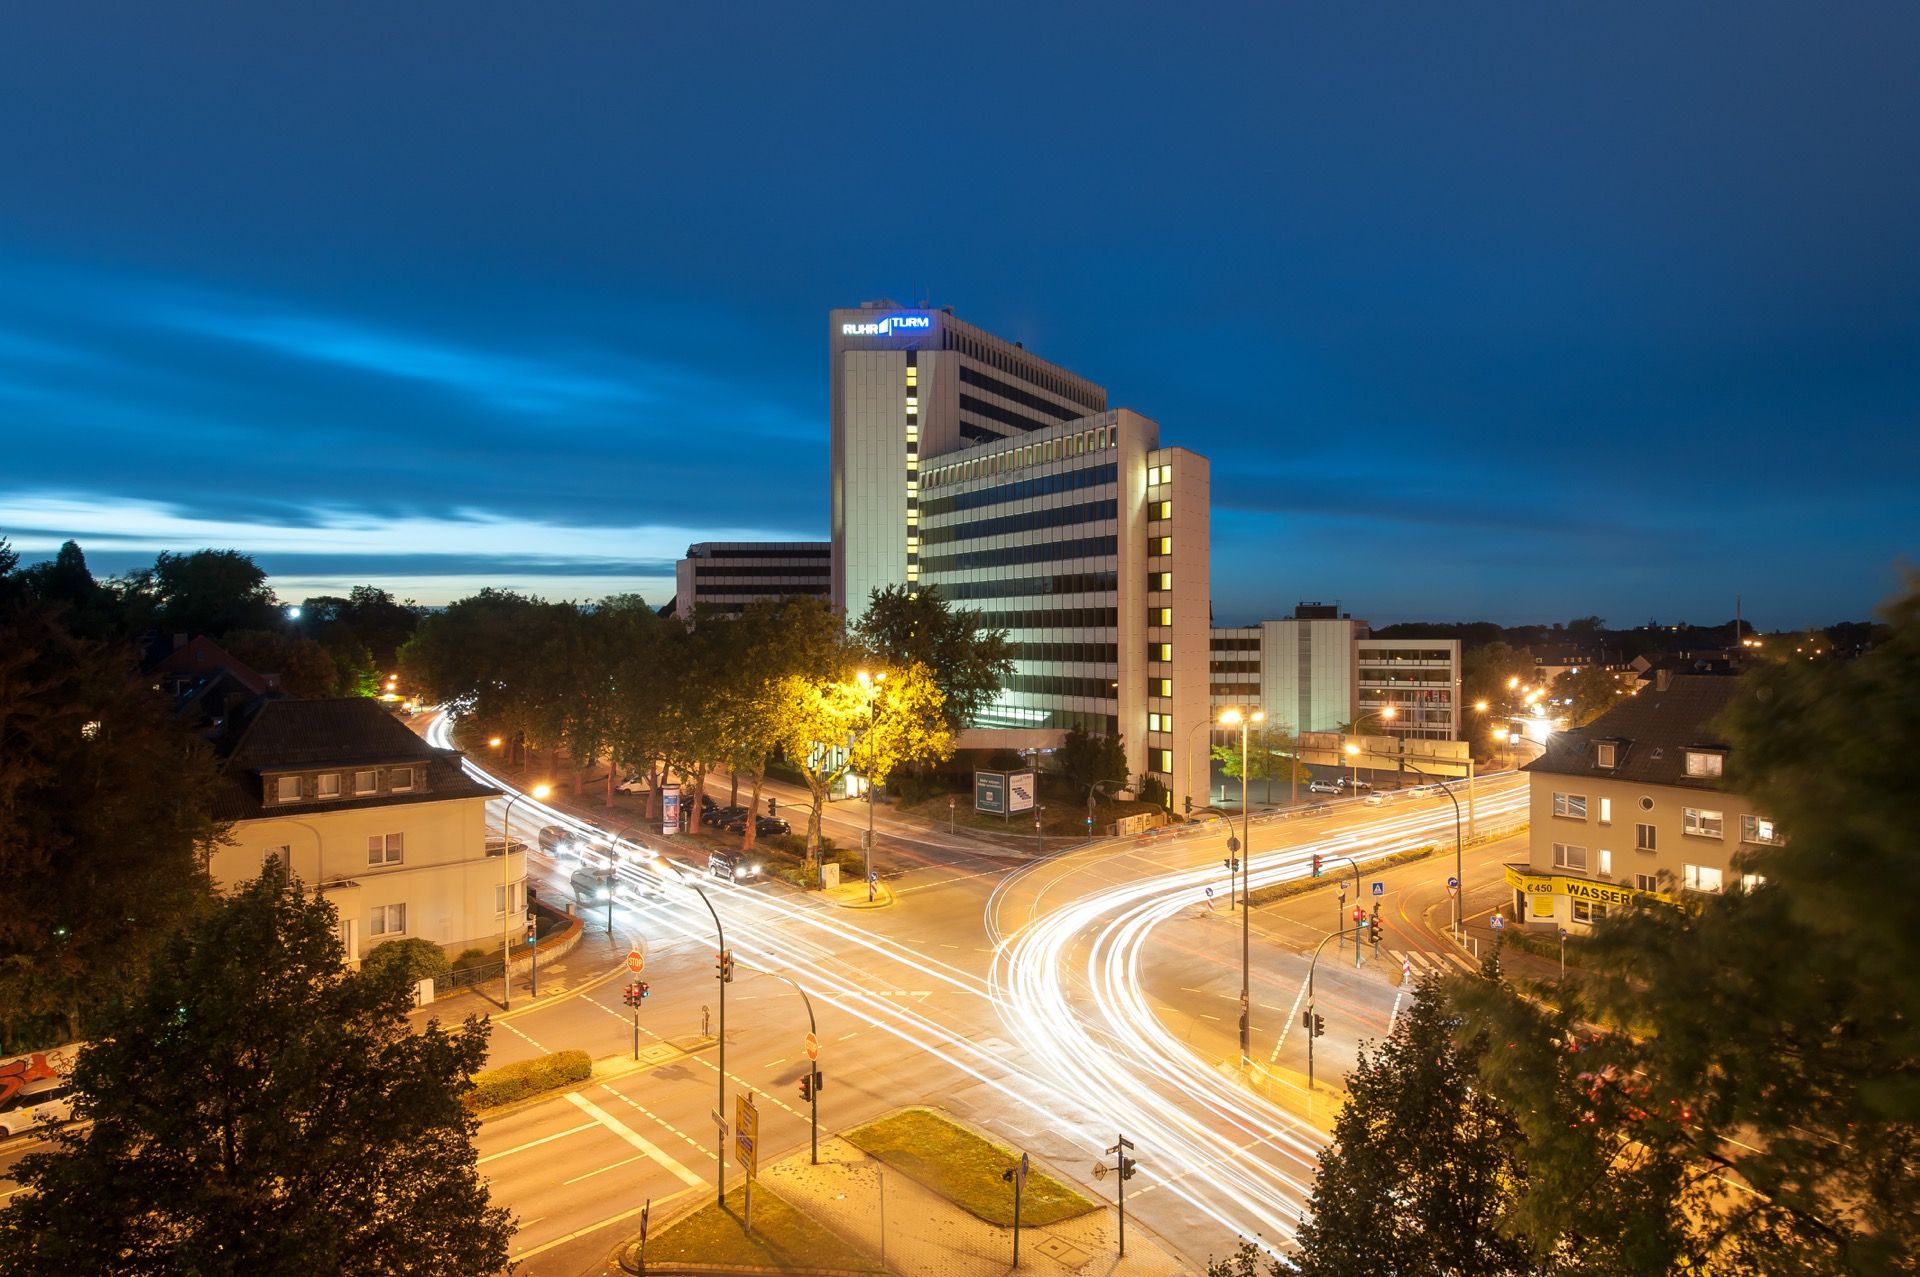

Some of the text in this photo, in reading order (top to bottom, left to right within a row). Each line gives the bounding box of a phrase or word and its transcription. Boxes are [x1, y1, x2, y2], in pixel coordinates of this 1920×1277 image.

[842, 318, 928, 334] RUHR TURM
[1566, 883, 1631, 905] WASSER
[629, 957, 642, 967] STOP
